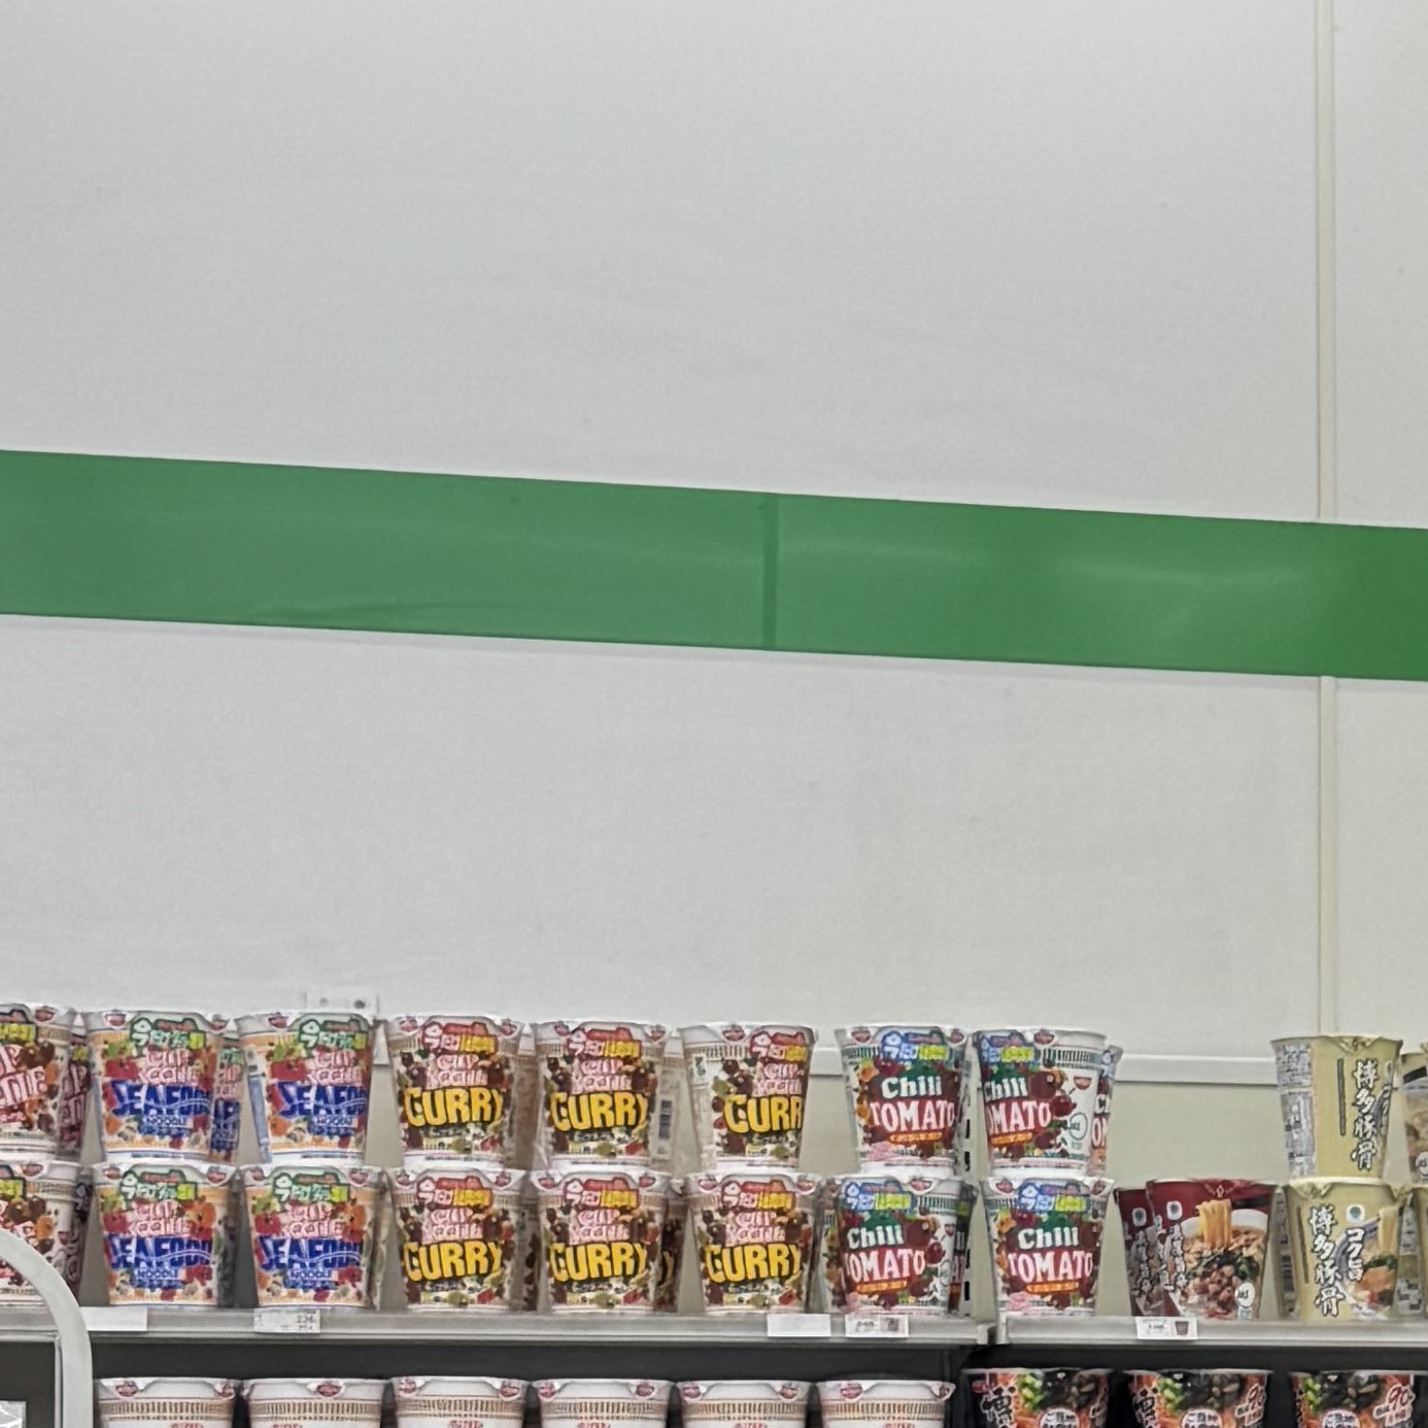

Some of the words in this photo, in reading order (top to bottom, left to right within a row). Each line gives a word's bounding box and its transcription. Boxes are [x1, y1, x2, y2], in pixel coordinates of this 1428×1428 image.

[880, 1076, 942, 1099] Chili
[548, 1092, 647, 1130] CURRY
[869, 1102, 956, 1132] TOMATO
[848, 1224, 902, 1249] Chili
[1017, 1226, 1078, 1247] Chili
[705, 1243, 800, 1284] CURRY
[1007, 1250, 1093, 1278] TOMATO
[1308, 1202, 1345, 1319] 博多豚骨
